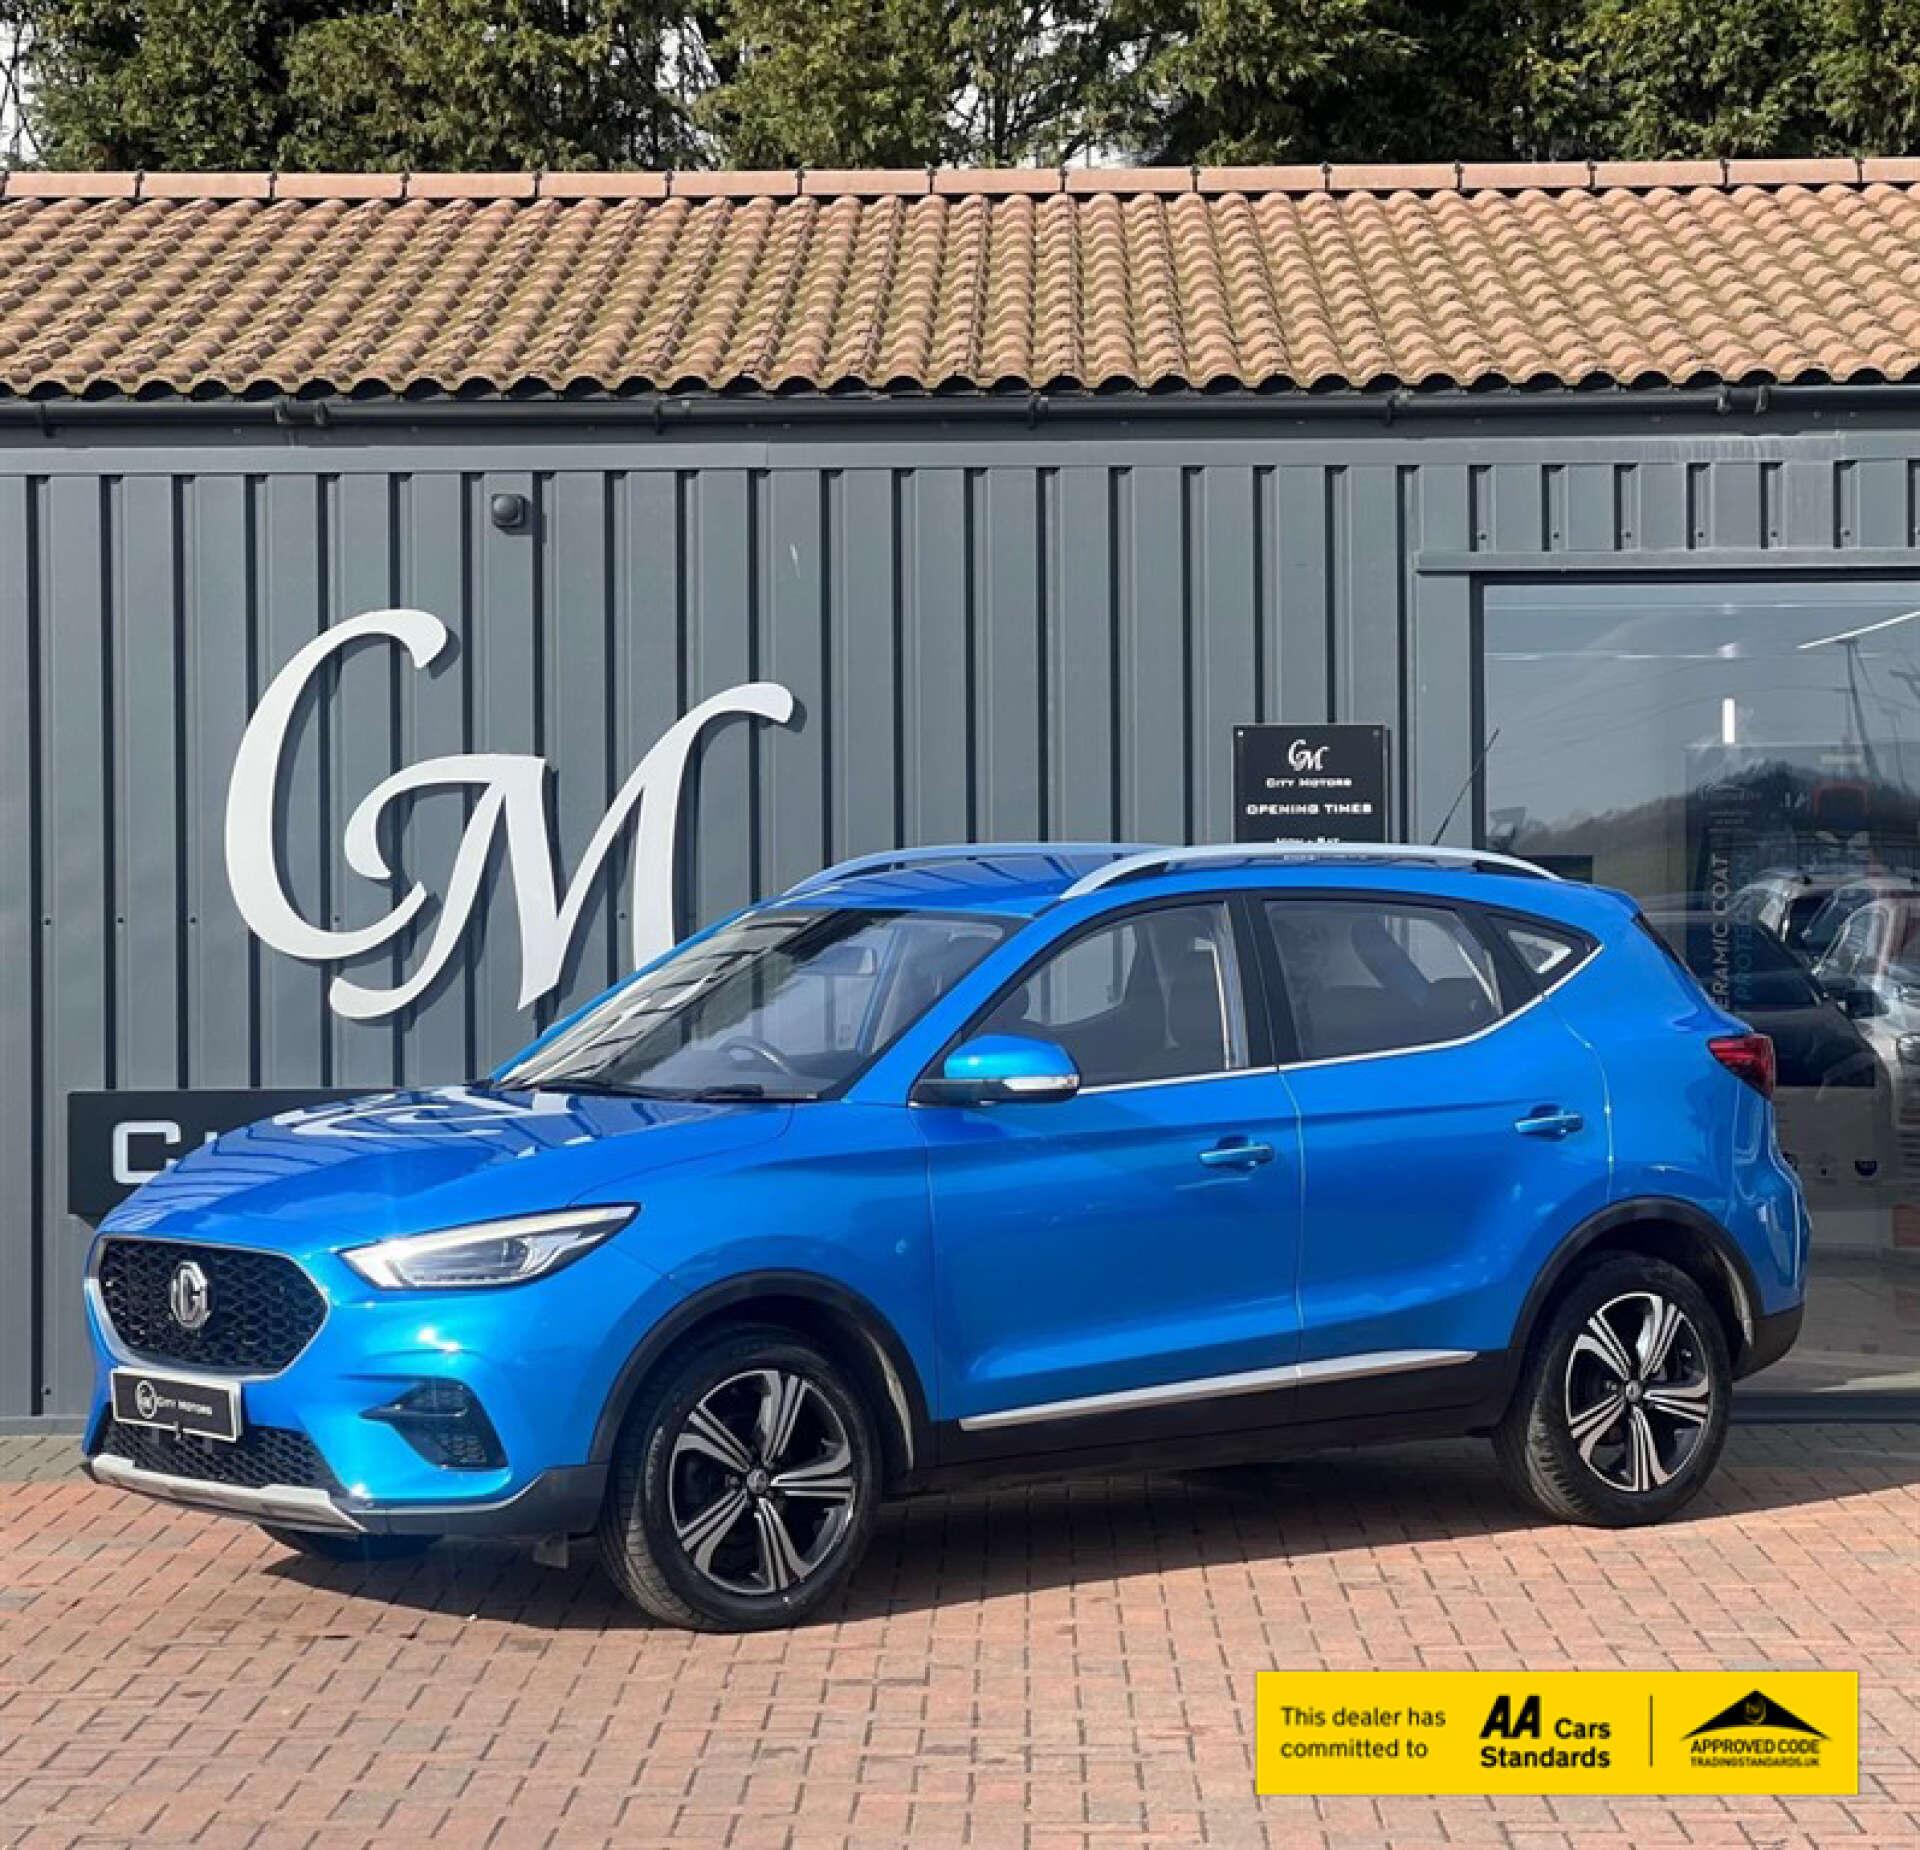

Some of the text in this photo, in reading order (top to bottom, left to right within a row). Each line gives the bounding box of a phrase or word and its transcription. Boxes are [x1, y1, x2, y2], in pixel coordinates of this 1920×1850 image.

[225, 608, 794, 1018] CM
[1247, 803, 1373, 815] OPENING TIMES
[1711, 918, 1730, 1010] ERAMIC
